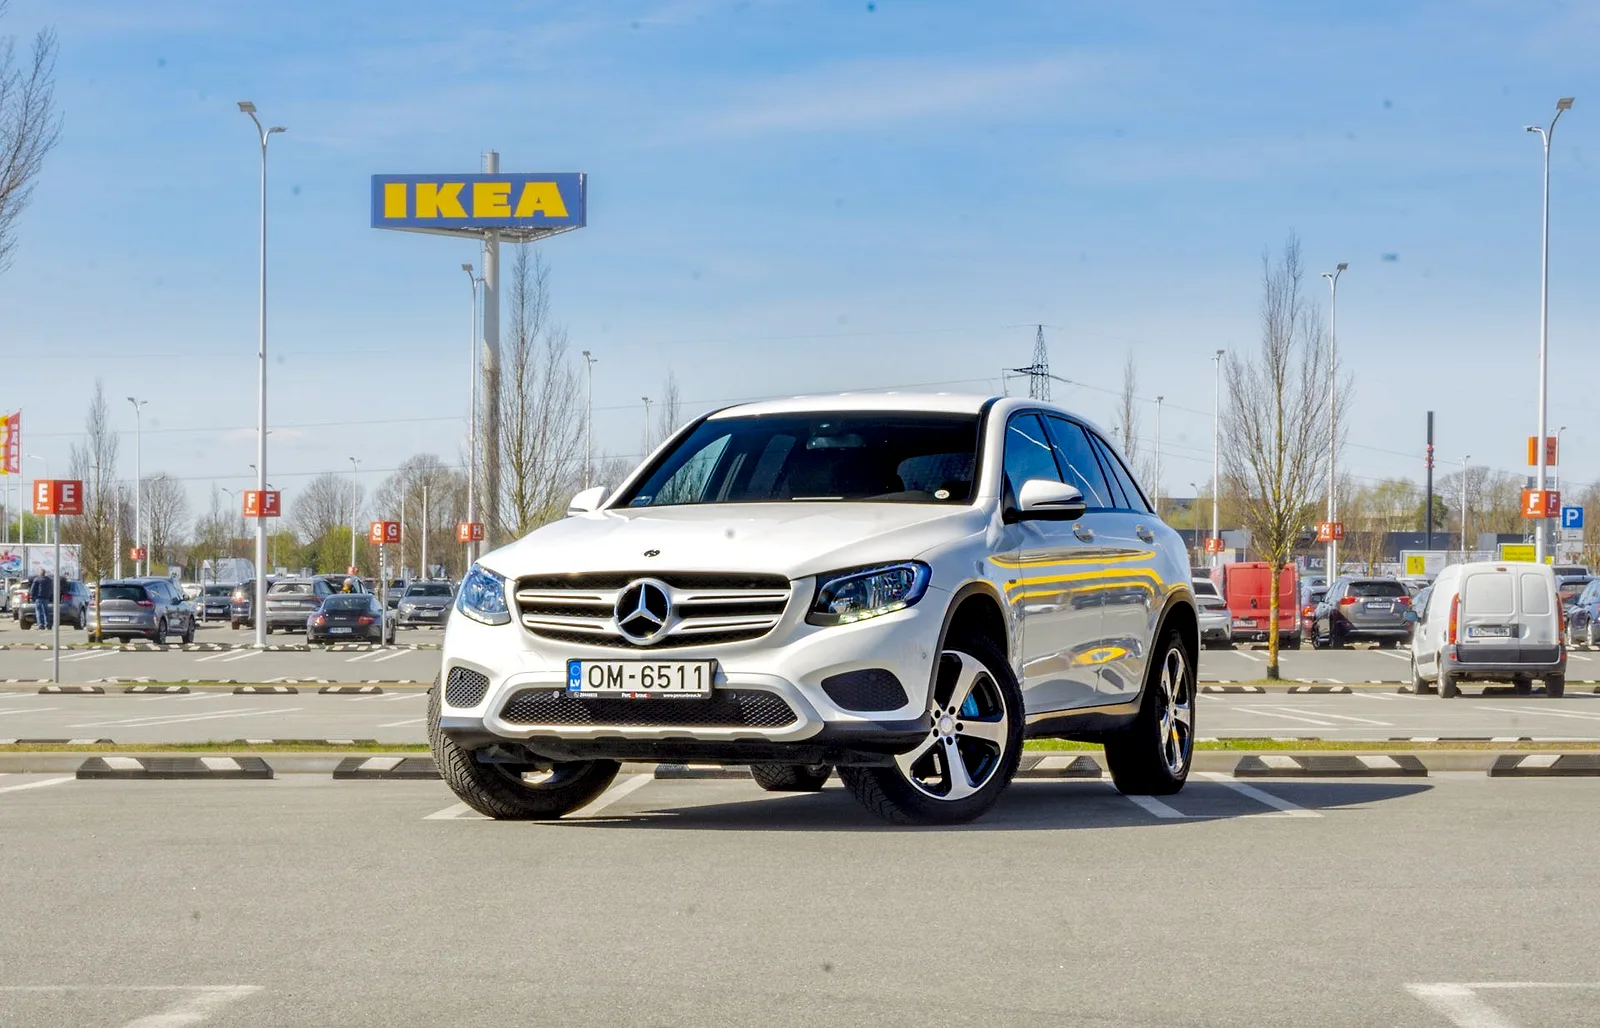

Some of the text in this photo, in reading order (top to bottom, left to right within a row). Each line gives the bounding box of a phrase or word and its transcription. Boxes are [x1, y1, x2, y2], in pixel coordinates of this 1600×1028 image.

[384, 181, 569, 219] IKEA
[38, 483, 49, 503] E
[62, 483, 75, 503] E
[247, 492, 256, 508] F
[265, 493, 275, 508] F
[1529, 493, 1540, 508] F
[1549, 493, 1557, 508] F
[1566, 508, 1579, 527] P
[373, 523, 382, 536] G
[388, 523, 397, 536] G
[461, 524, 468, 535] H
[473, 524, 481, 535] H
[1321, 523, 1330, 534] H
[1335, 524, 1342, 534] H
[570, 679, 581, 687] LV
[588, 664, 703, 689] OM-6511
